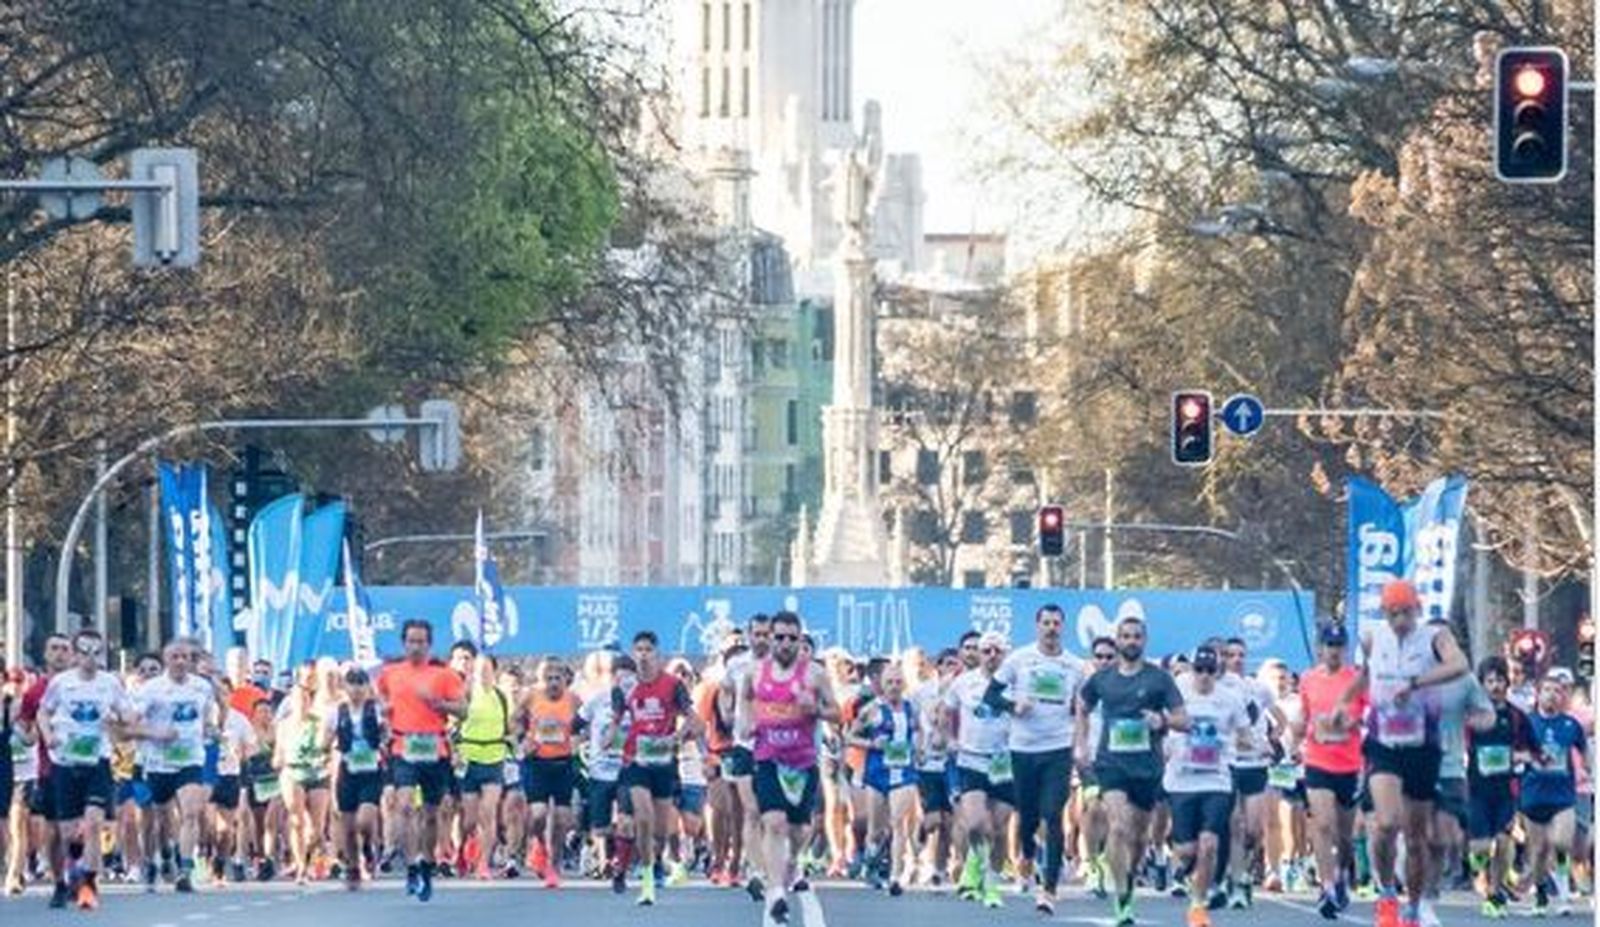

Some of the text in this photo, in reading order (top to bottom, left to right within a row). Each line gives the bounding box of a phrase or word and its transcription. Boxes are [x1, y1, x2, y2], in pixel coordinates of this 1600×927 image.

[577, 602, 620, 616] MAD
[970, 605, 1013, 619] MAD
[577, 618, 620, 640] 1/2
